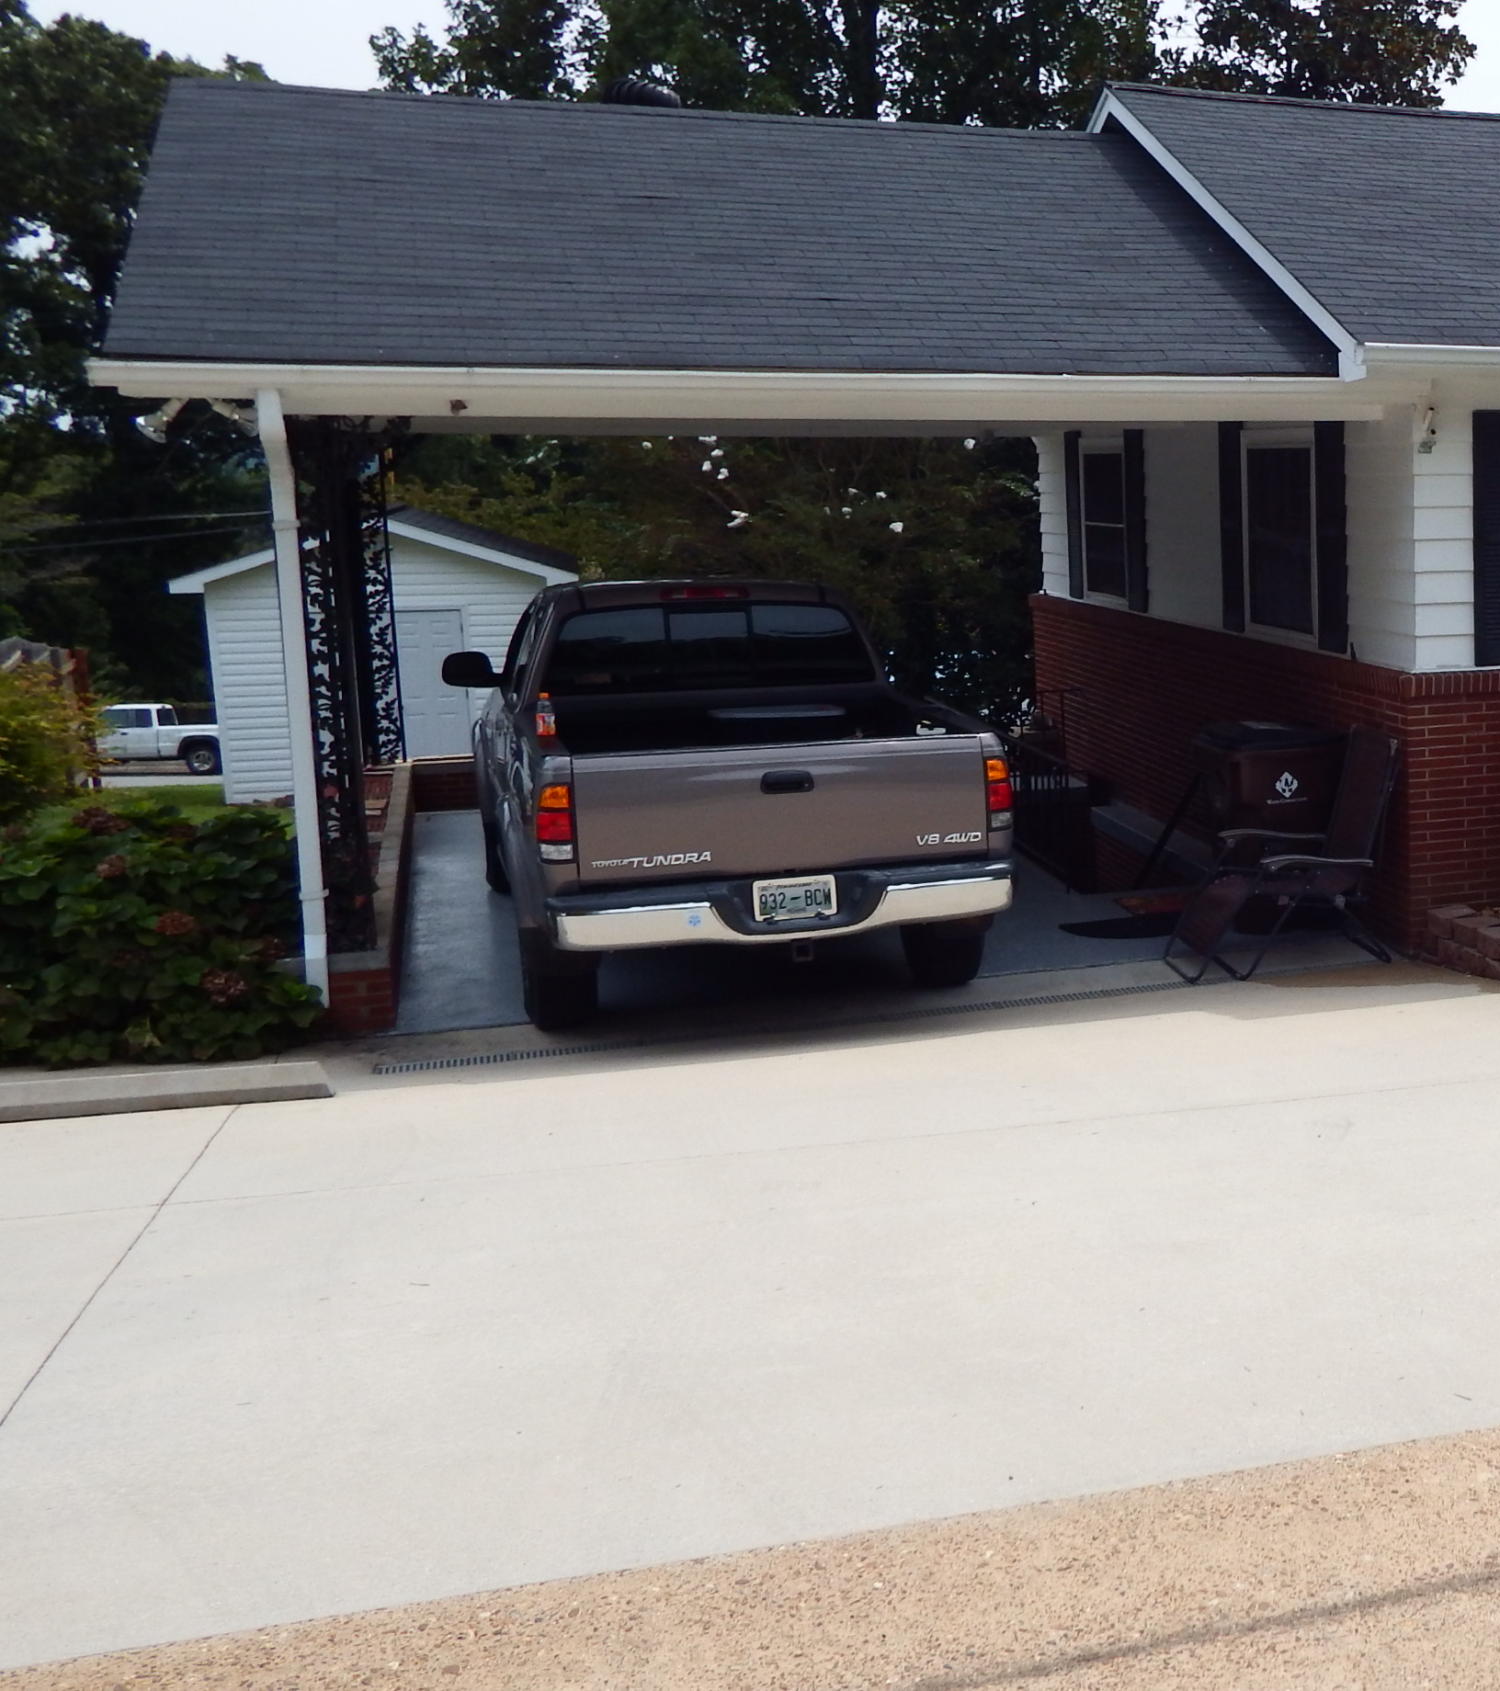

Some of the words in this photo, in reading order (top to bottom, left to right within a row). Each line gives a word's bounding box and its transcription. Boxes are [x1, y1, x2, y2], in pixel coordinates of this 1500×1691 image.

[916, 833, 940, 846] V8
[943, 831, 982, 843] 4WD
[626, 851, 712, 869] TUNDRA
